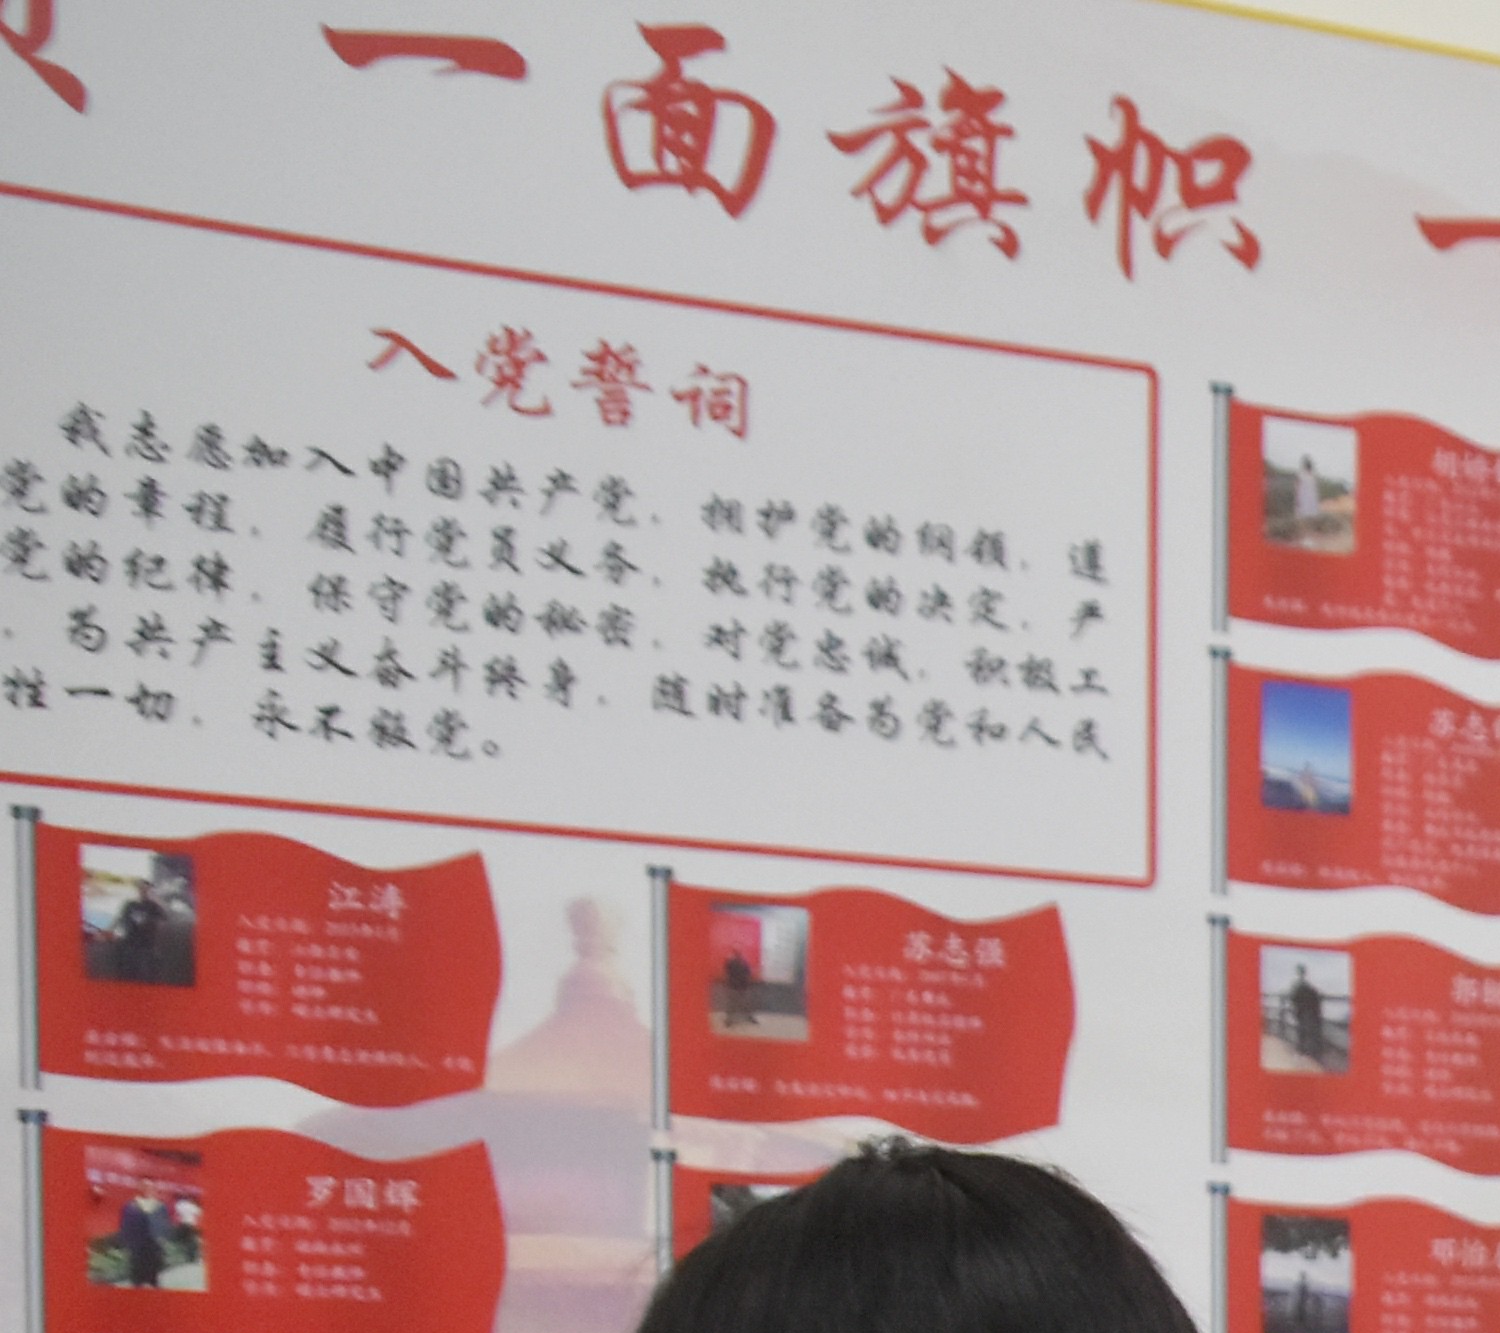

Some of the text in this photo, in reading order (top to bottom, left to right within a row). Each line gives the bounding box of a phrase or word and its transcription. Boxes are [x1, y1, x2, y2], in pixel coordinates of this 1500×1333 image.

[322, 20, 1262, 279] 一面旗帜
[366, 326, 752, 441] 入党誓词
